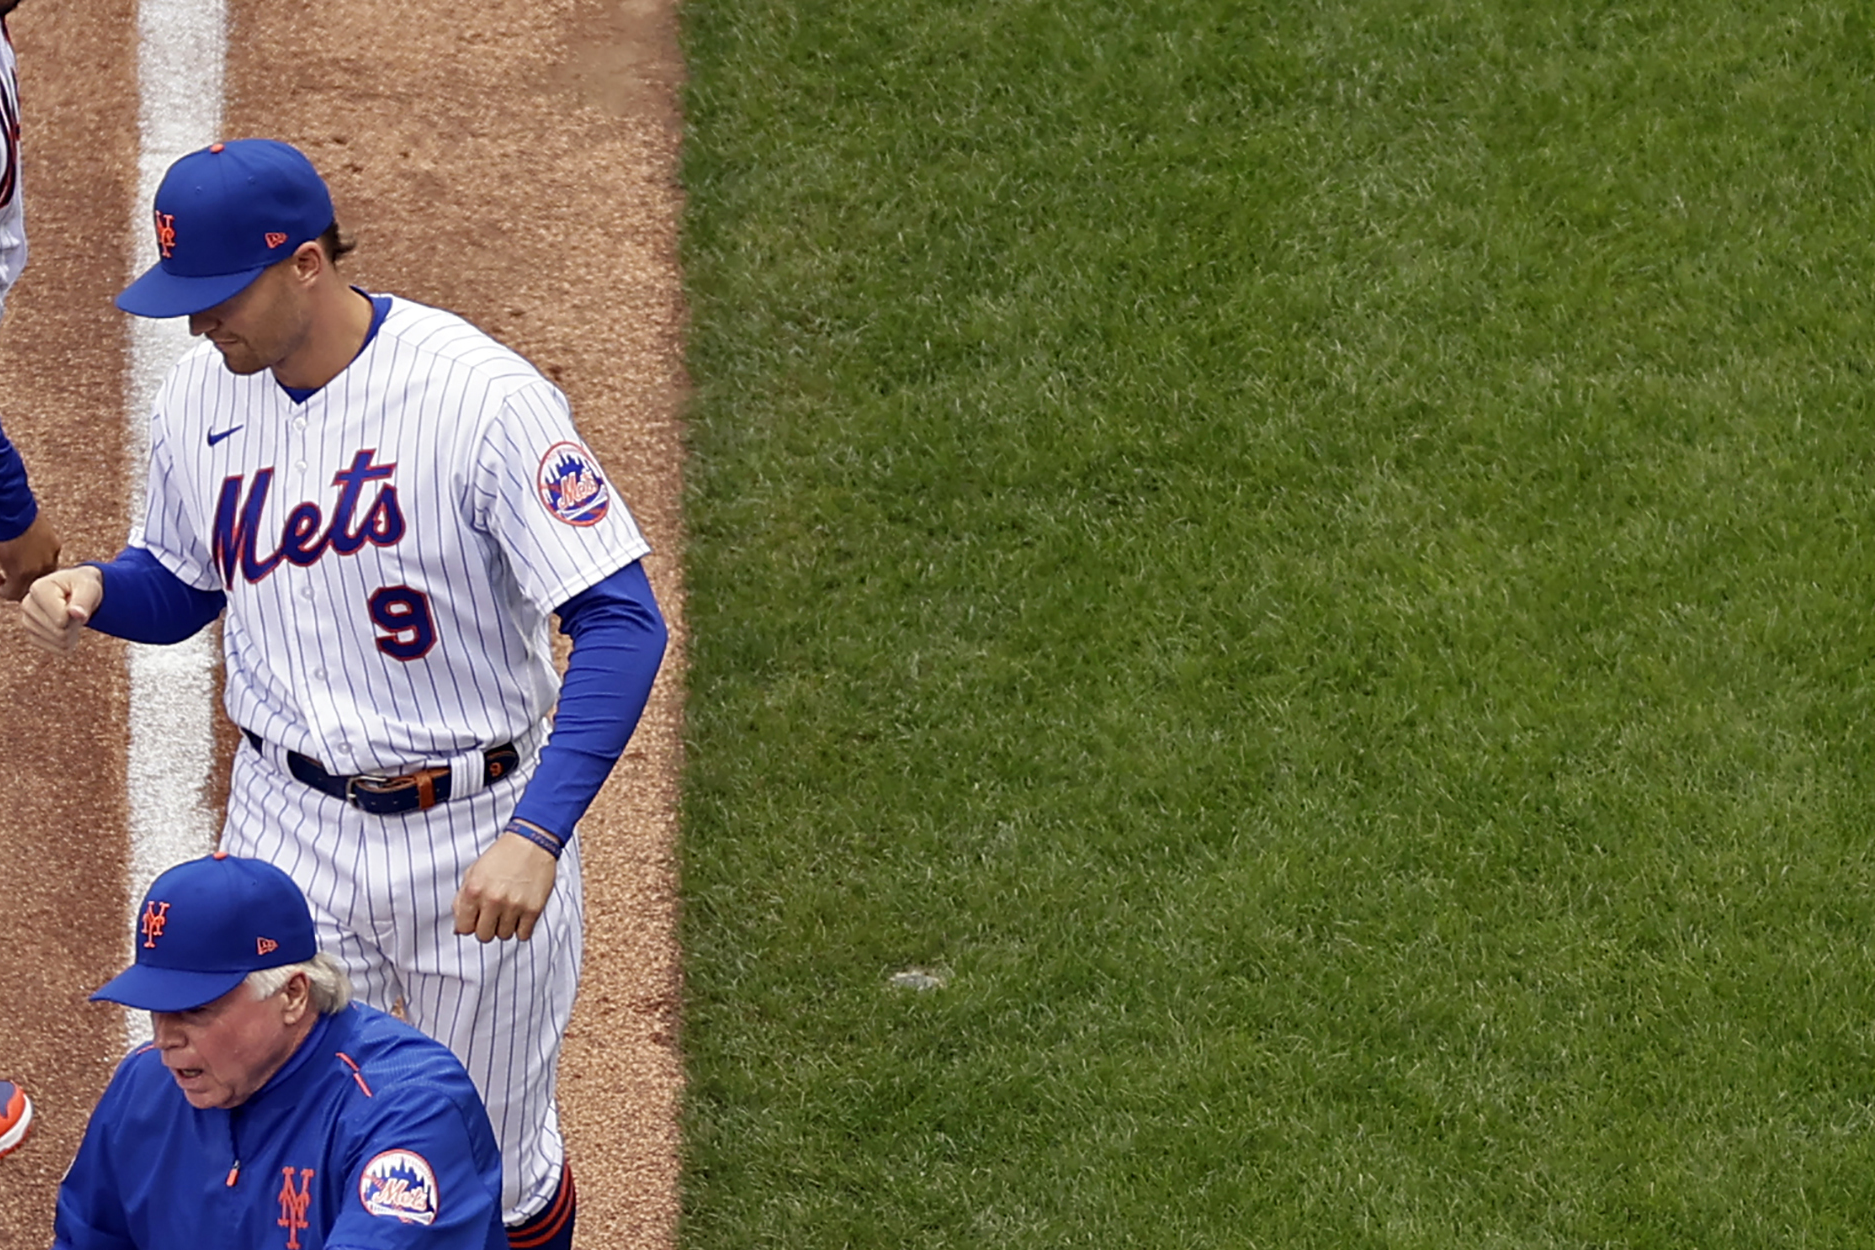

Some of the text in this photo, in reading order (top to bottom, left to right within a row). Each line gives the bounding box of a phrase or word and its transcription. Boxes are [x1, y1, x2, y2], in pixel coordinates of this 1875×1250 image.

[213, 447, 406, 591] Mets
[367, 584, 438, 661] 9
[140, 900, 171, 948] NY
[277, 1166, 316, 1250] NY
[371, 1178, 428, 1212] Mets
